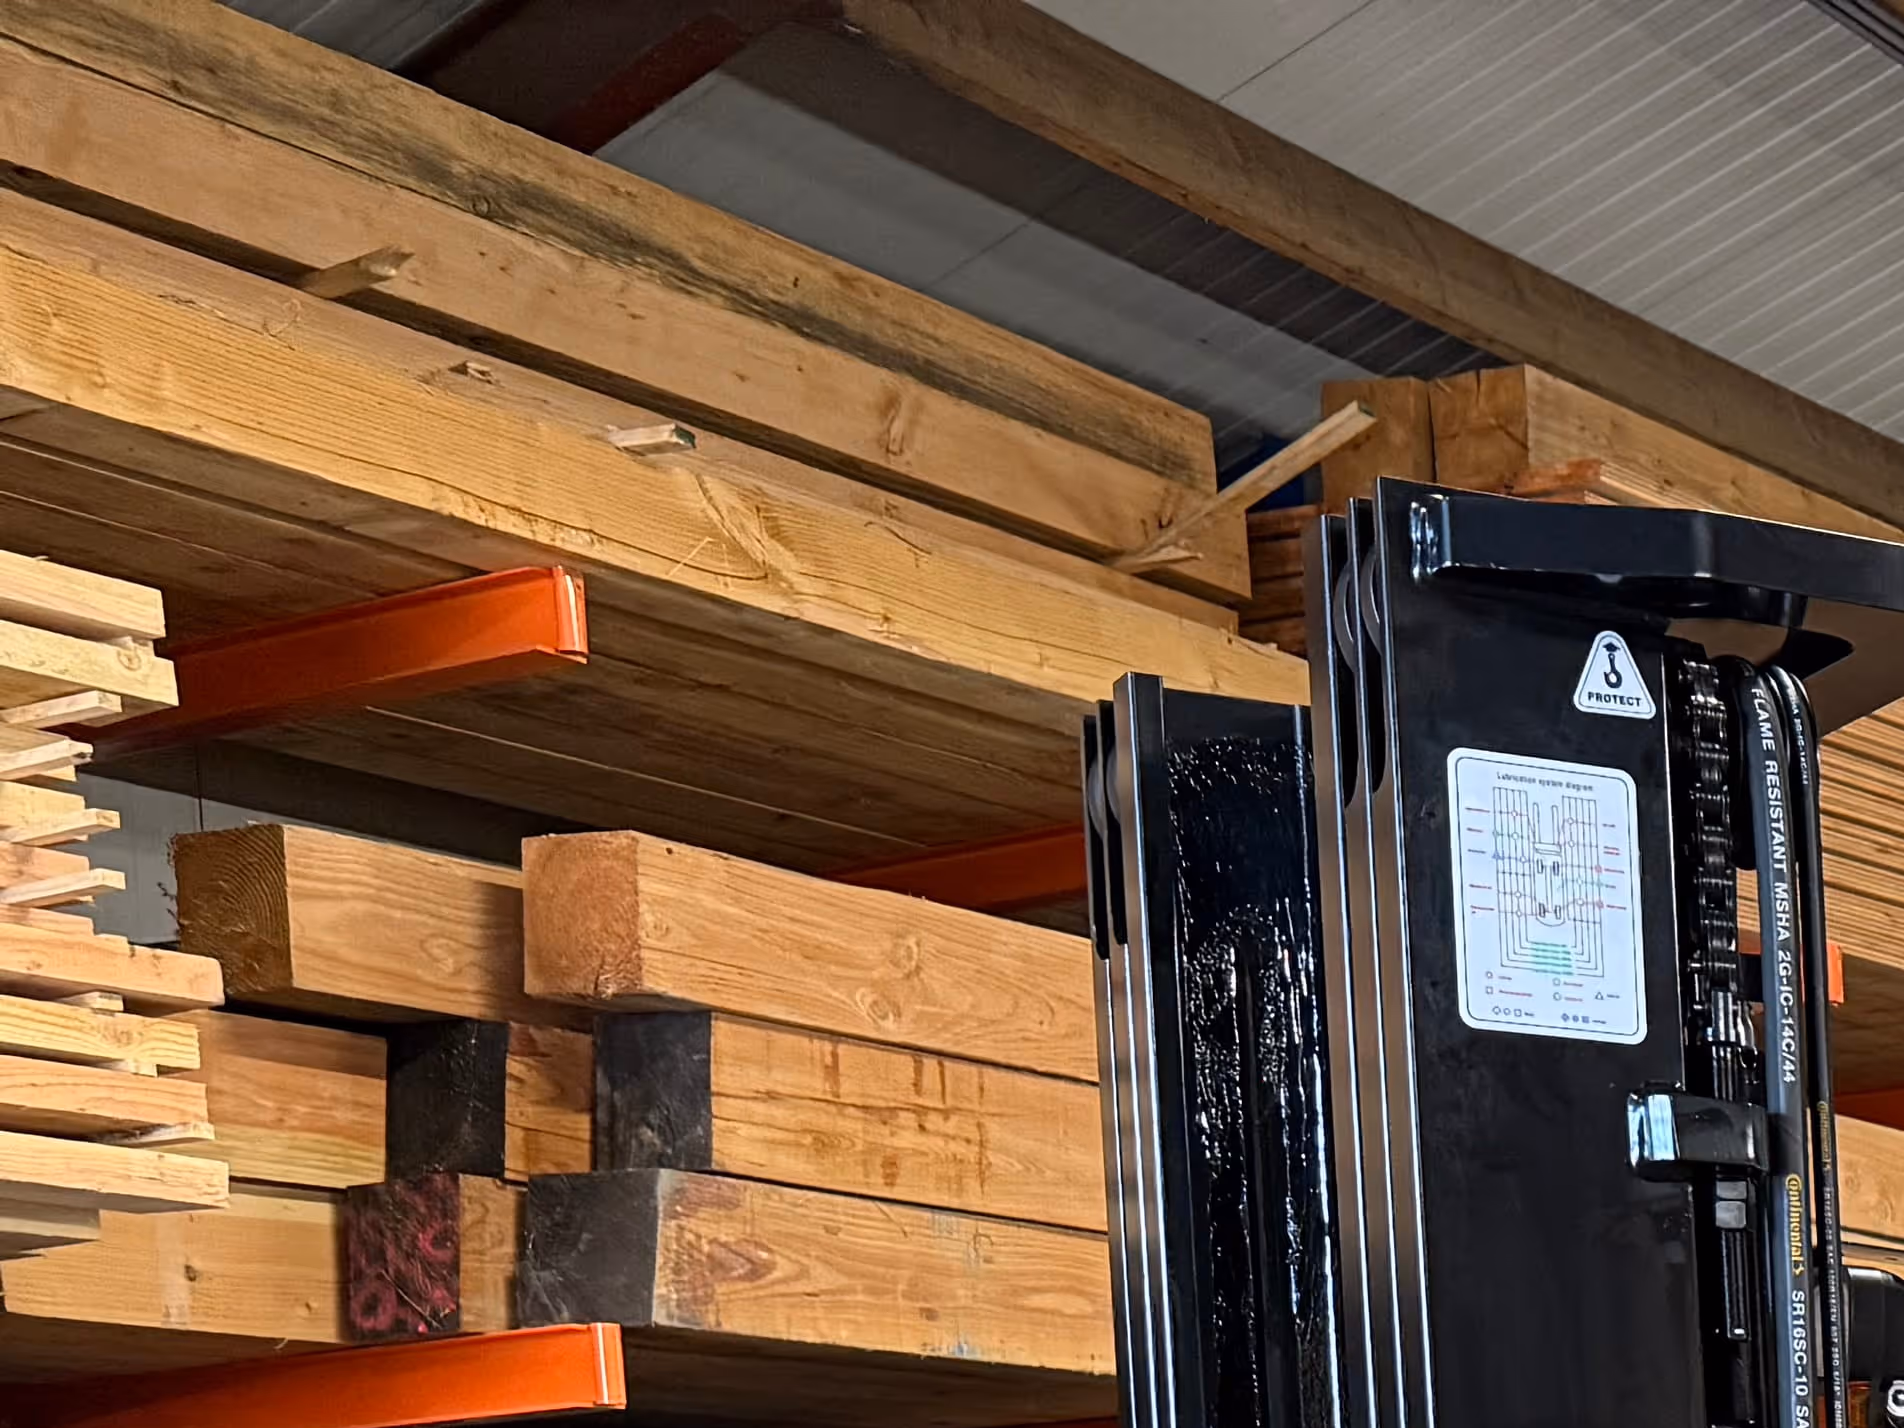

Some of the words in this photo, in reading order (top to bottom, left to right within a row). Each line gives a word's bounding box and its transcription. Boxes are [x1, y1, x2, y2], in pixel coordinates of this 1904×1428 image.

[1587, 690, 1642, 708] PROTECT
[1750, 687, 1776, 751] FLAME
[1763, 758, 1788, 873] RESISTANT
[1773, 881, 1791, 942] MSHA
[1776, 949, 1798, 1084] 2G-IC-14C/44
[1785, 1172, 1804, 1262] Continental
[1790, 1289, 1809, 1398] SR16SC-10
